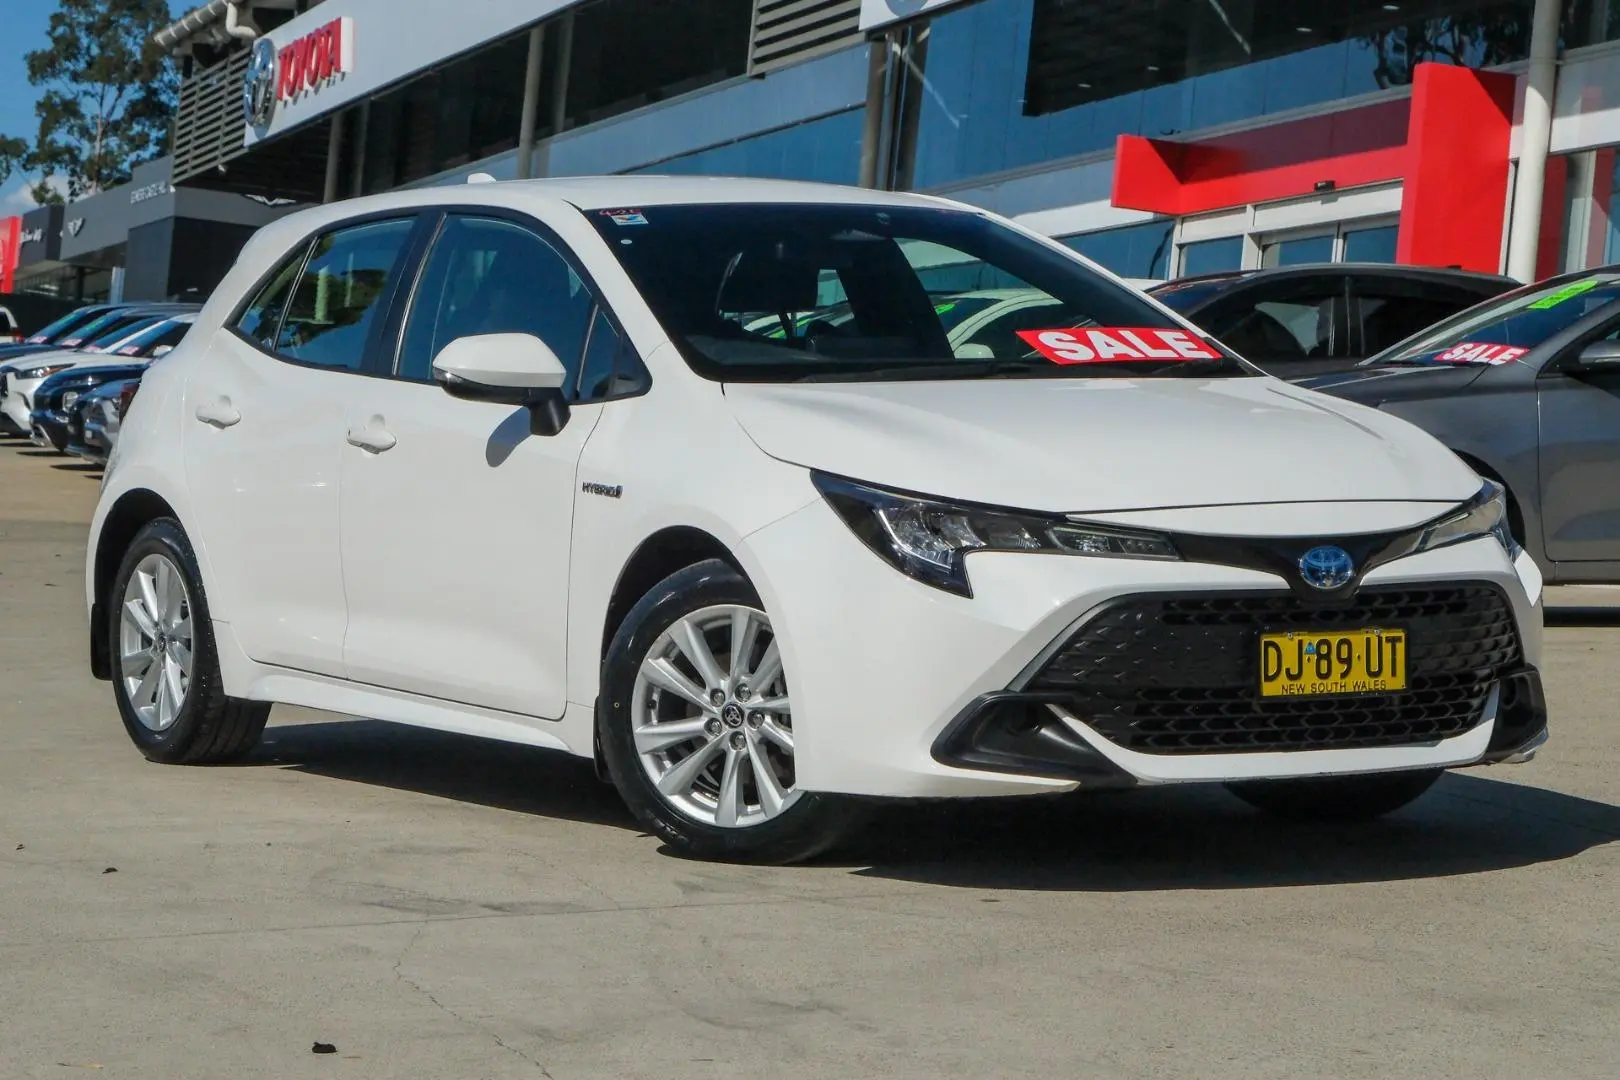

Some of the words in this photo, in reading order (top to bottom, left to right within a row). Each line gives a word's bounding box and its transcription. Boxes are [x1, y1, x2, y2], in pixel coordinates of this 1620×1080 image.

[277, 16, 341, 101] TOYOTA
[1038, 330, 1214, 360] SALE
[1443, 343, 1525, 365] SALE
[582, 481, 616, 498] HYBRID
[1281, 684, 1306, 695] NEW
[1310, 682, 1347, 693] SOUTH
[1352, 680, 1387, 691] WALES
